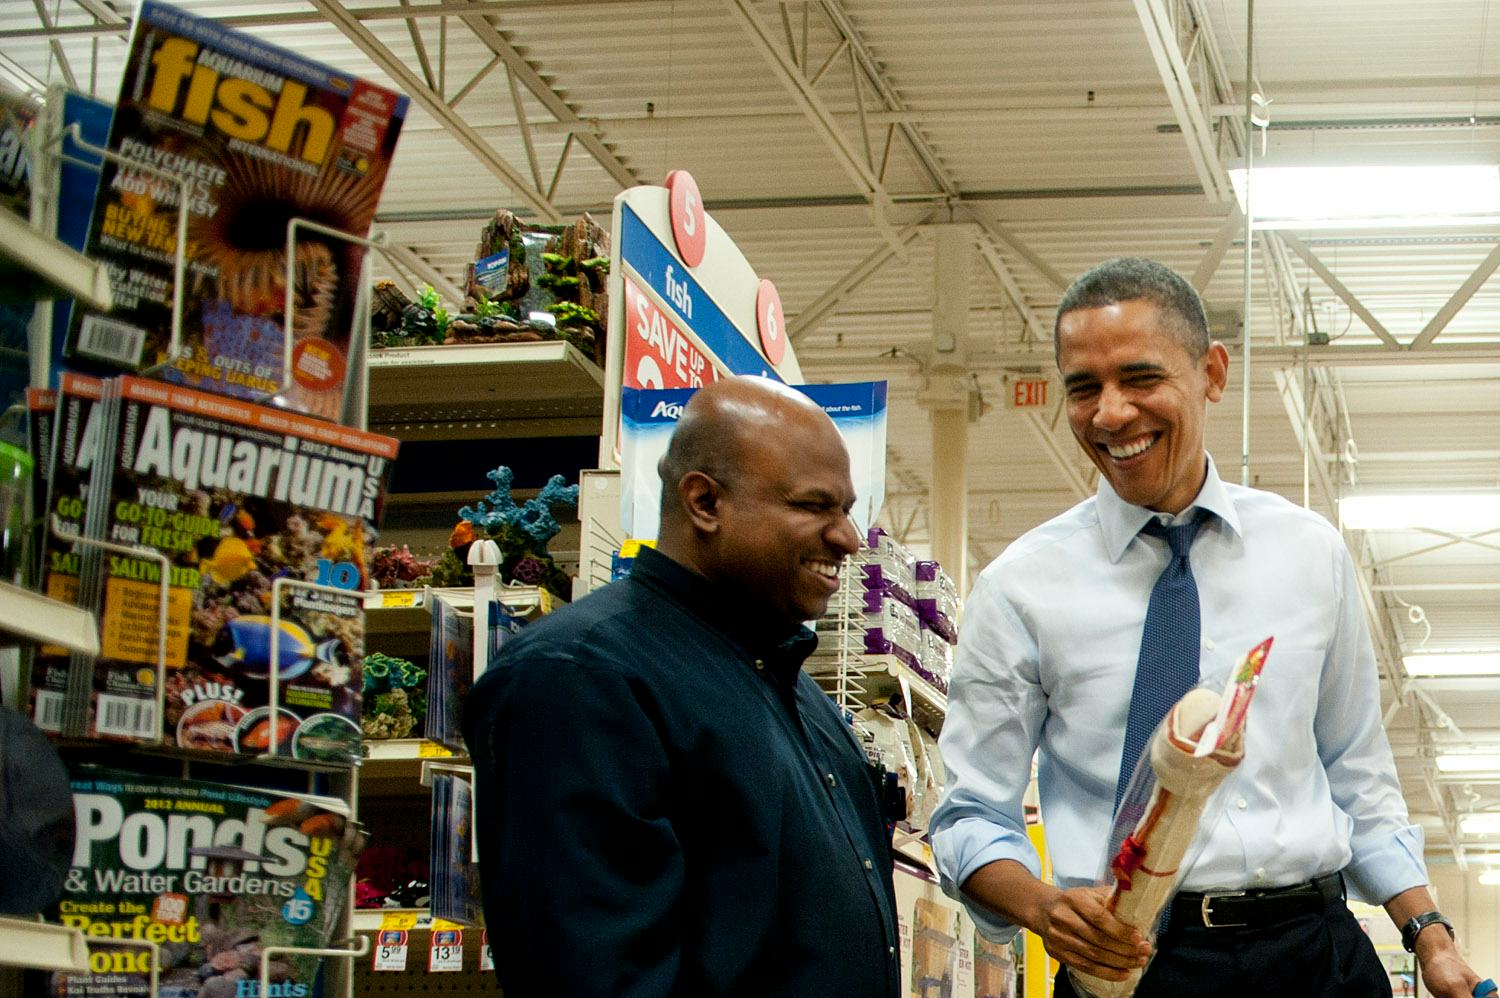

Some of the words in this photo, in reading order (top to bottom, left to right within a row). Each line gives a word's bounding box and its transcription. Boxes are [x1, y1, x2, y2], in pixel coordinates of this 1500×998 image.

[150, 36, 335, 166] fish
[683, 191, 697, 238] 5
[665, 264, 694, 321] fish
[765, 302, 778, 342] 6
[635, 293, 690, 384] SAVE
[689, 349, 706, 373] UP
[1014, 380, 1049, 407] EXIT
[133, 405, 367, 517] Aquarium
[138, 487, 179, 511] YOUR
[112, 523, 140, 543] FOR
[141, 525, 193, 551] FRESH
[110, 554, 201, 589] SALTWTER
[314, 558, 361, 591] 10
[180, 681, 245, 707] PLUS!
[143, 799, 172, 810] 2012
[174, 800, 226, 815] ANNUAL
[70, 793, 310, 877] Ponds
[63, 867, 88, 893] &
[95, 868, 178, 895] Water
[183, 870, 296, 899] Gardens
[60, 900, 116, 914] Create
[117, 901, 147, 914] the
[286, 897, 313, 920] 15
[60, 913, 202, 945] Perfect
[235, 976, 309, 998] Hnts
